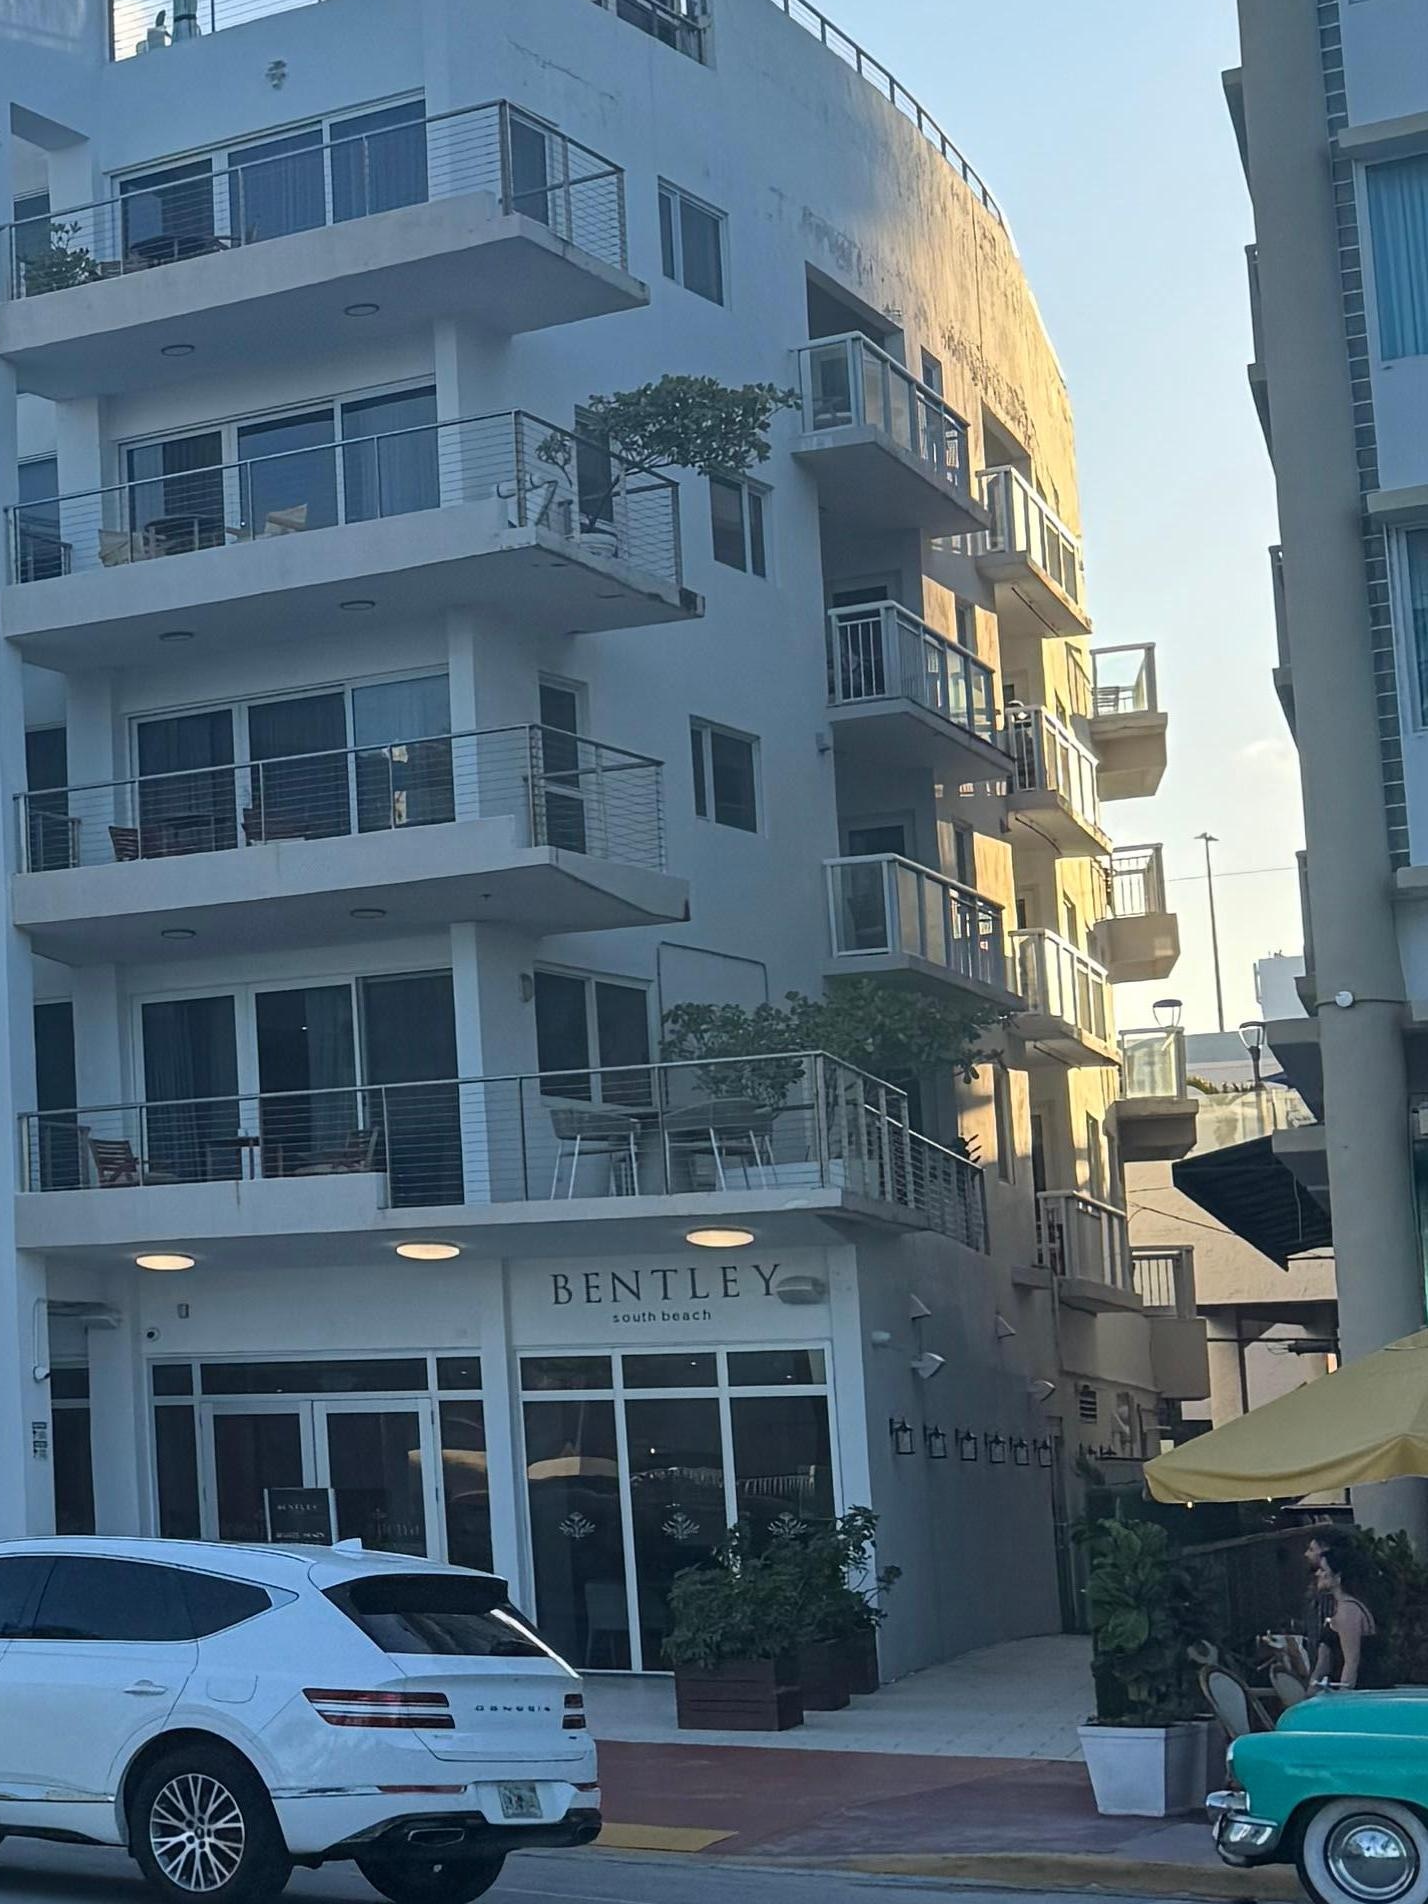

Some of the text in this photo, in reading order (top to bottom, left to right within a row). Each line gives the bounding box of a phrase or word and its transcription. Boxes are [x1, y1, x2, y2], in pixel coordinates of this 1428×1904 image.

[551, 1263, 781, 1305] BENTLEY
[612, 1309, 711, 1323] south beach
